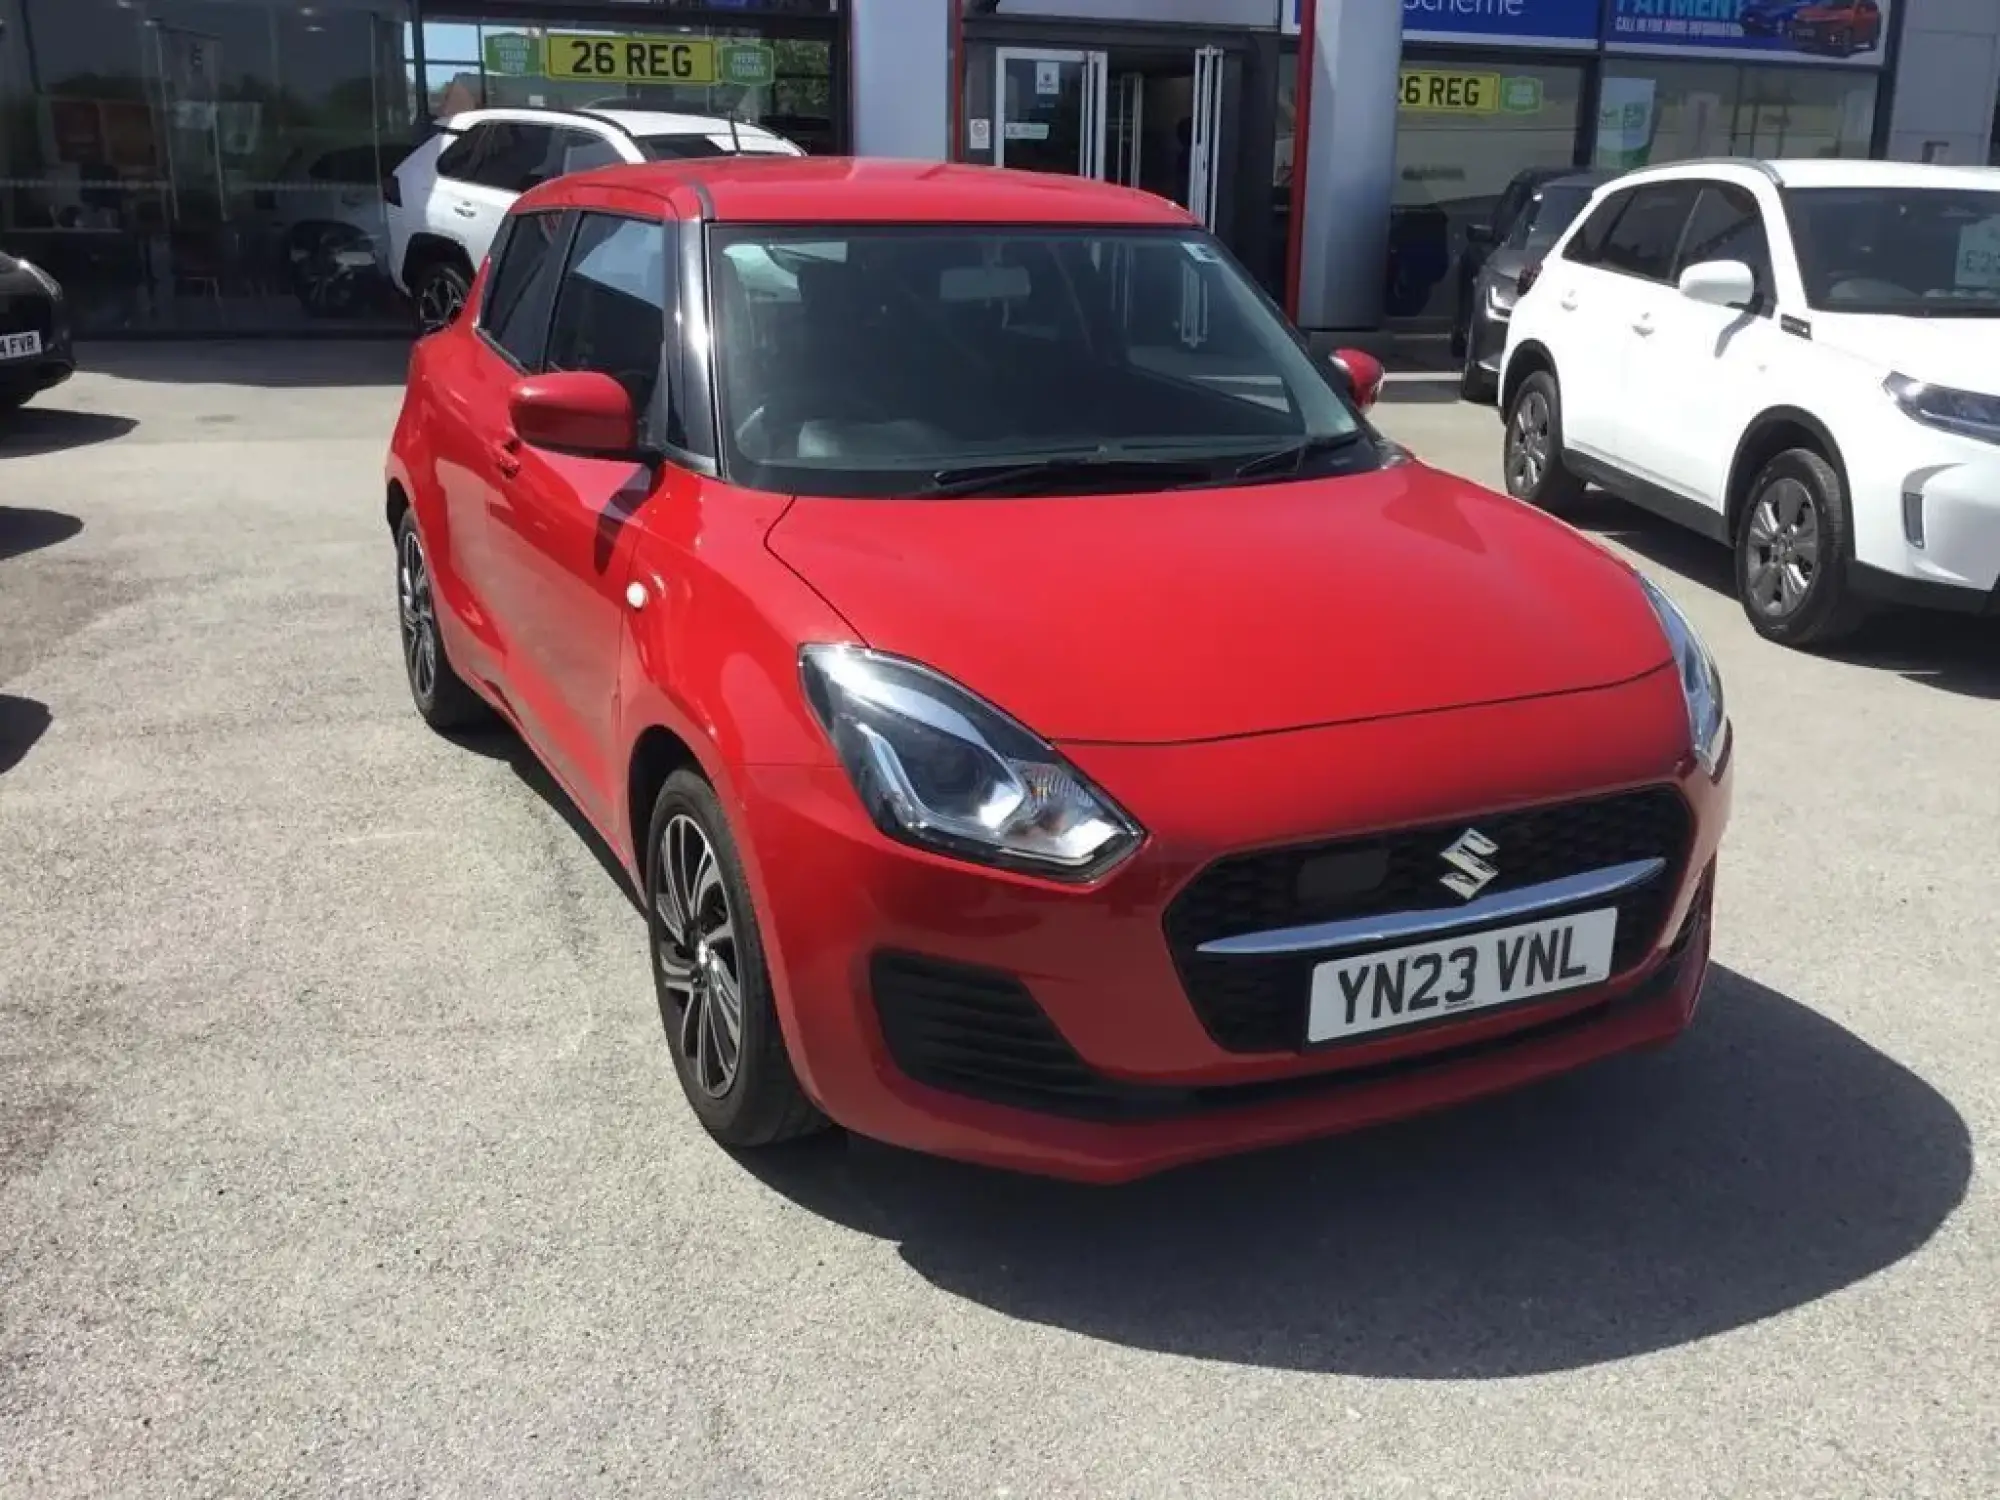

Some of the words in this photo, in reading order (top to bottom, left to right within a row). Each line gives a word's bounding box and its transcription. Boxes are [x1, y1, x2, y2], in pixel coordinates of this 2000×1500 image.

[571, 41, 616, 75] 26
[626, 43, 692, 77] REG
[1399, 75, 1421, 104] 6
[1430, 76, 1480, 106] REG
[1338, 947, 1478, 1024] YN23
[1497, 926, 1587, 992] VNL
